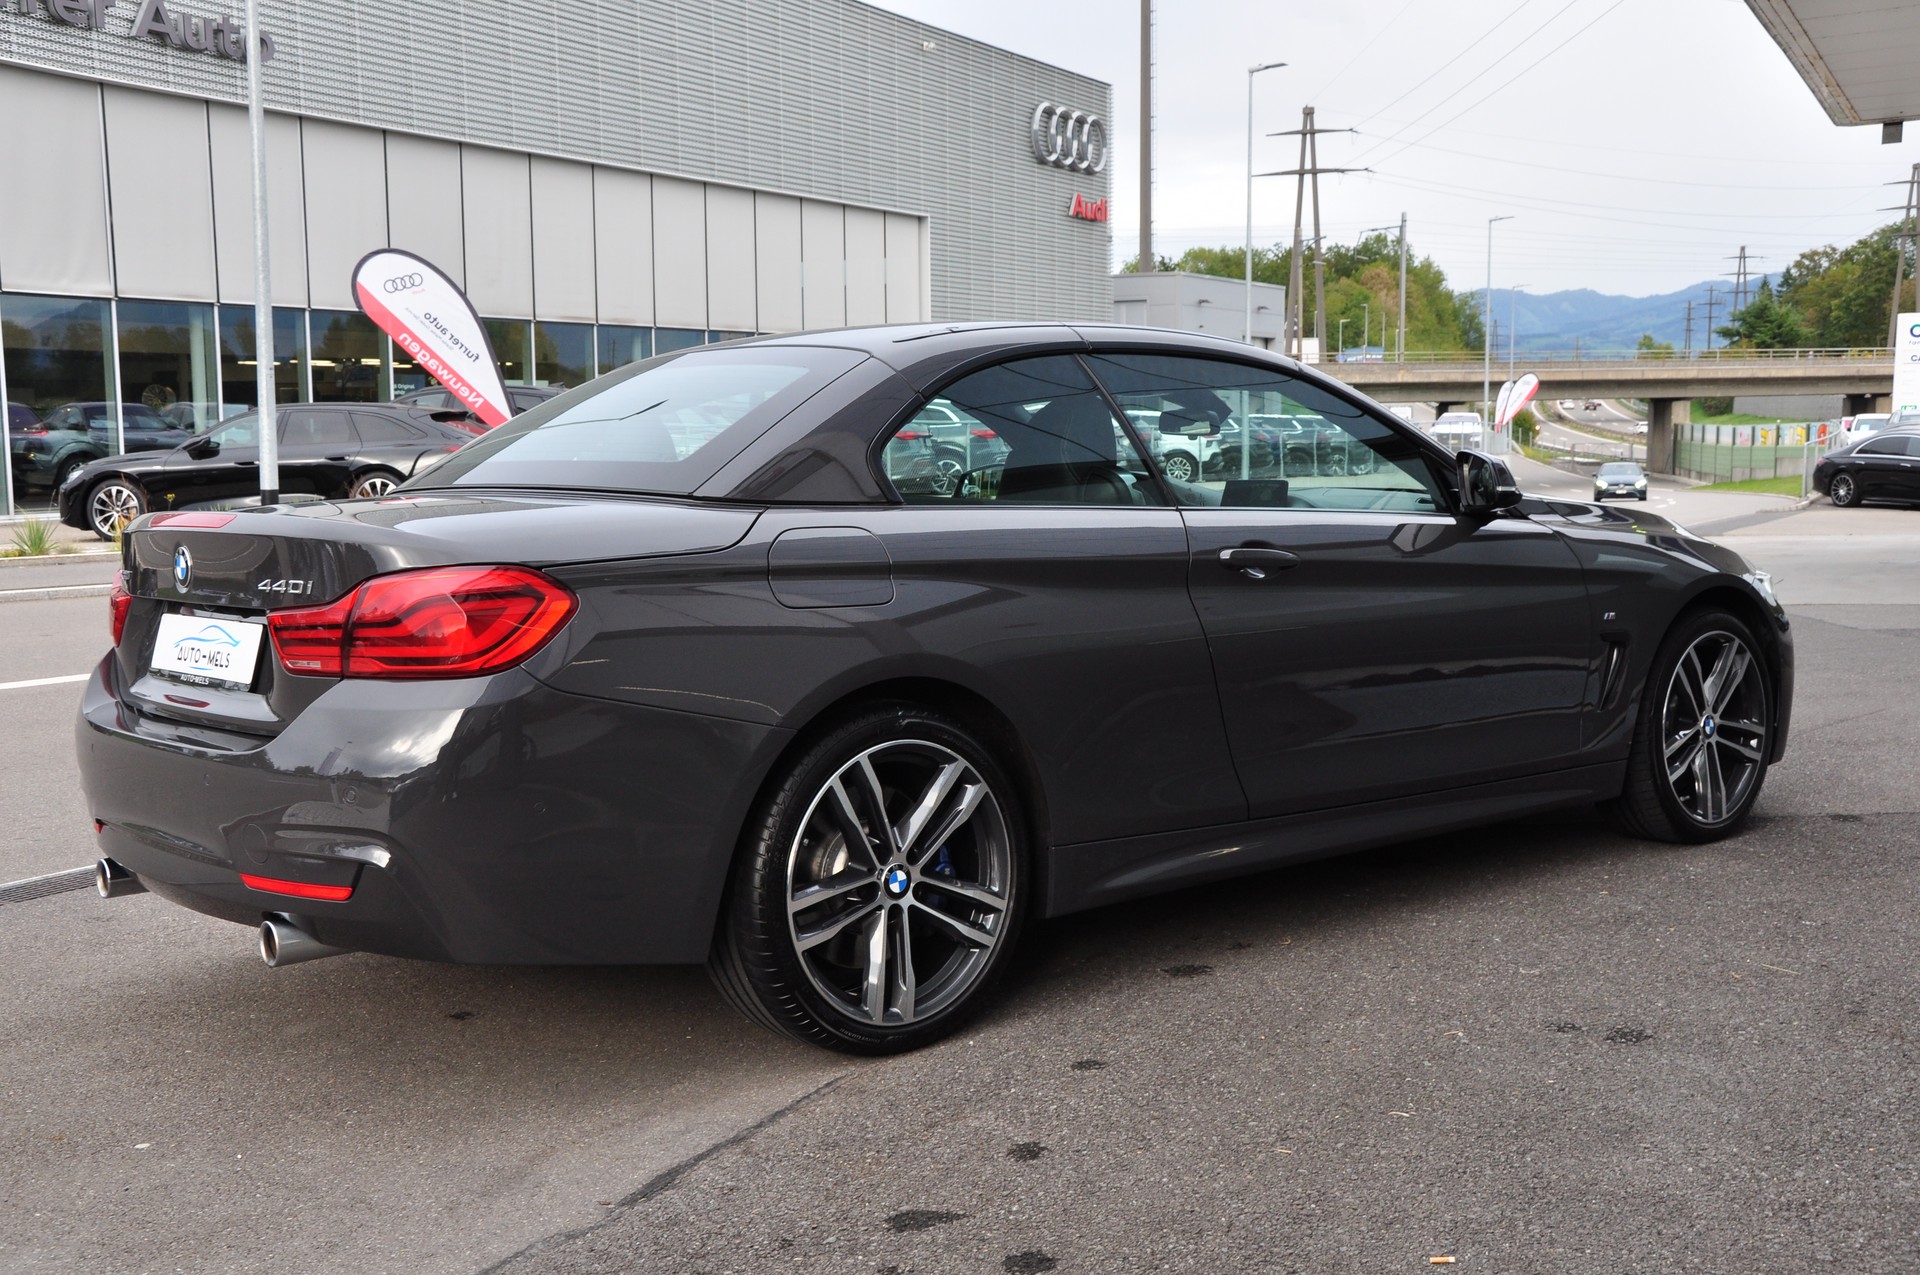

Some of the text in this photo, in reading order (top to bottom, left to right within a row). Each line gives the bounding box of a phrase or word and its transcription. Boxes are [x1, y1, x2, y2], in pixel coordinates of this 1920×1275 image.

[1071, 192, 1108, 222] Audi
[257, 578, 314, 595] 440i
[180, 673, 210, 685] AUTO-MELS
